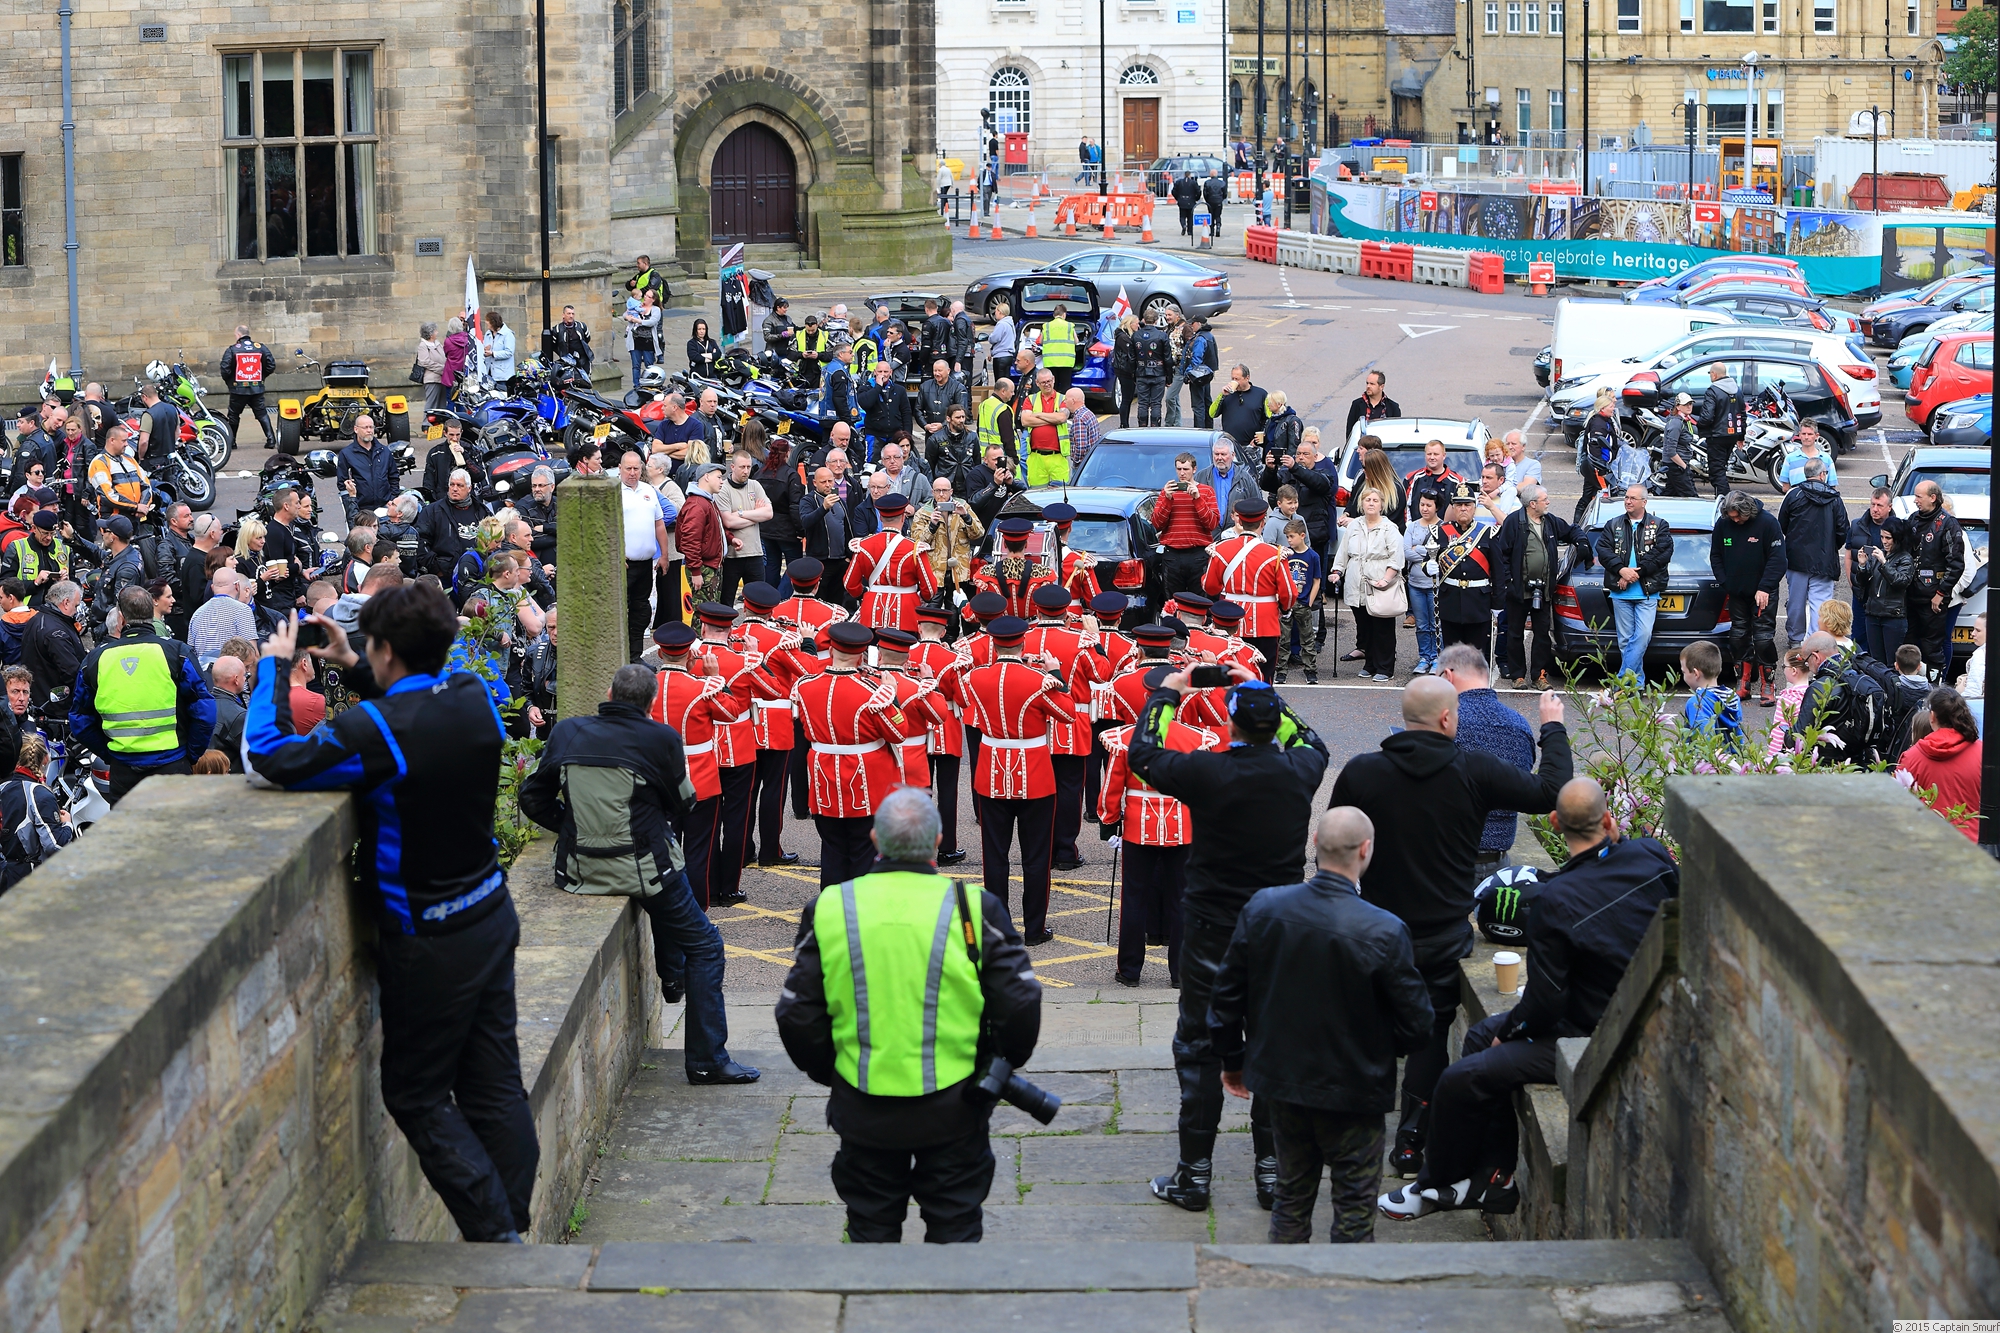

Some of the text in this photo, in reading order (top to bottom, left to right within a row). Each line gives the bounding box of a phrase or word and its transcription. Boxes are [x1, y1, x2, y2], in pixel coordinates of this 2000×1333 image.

[1719, 69, 1765, 80] BARCLYS
[1519, 248, 1532, 262] to
[1612, 251, 1690, 273] heritage
[241, 356, 258, 364] Ride
[237, 369, 261, 380] Respect
